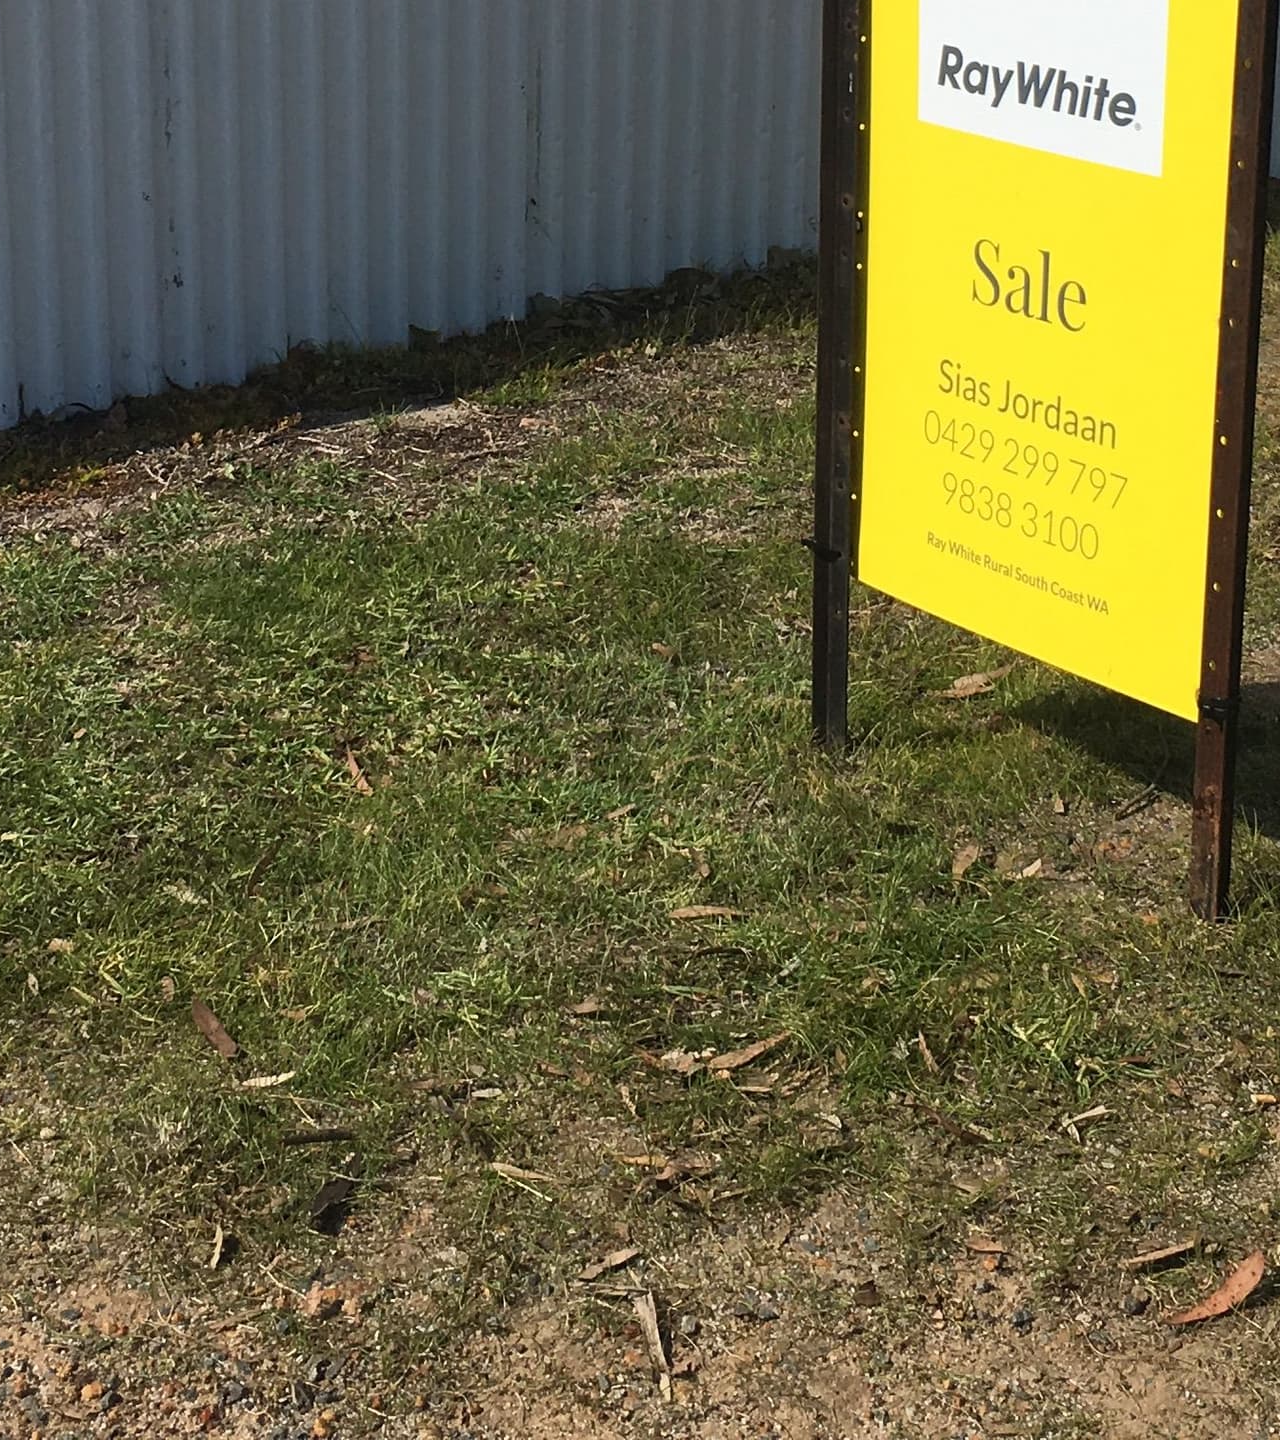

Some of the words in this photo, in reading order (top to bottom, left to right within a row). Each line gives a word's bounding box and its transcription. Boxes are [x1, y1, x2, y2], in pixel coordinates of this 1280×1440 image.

[971, 238, 1087, 333] Sale
[938, 358, 991, 408] Sias
[997, 379, 1117, 450] Jordaan
[924, 409, 995, 464] 0429
[1002, 437, 1059, 487] 299
[1069, 458, 1128, 510] 797
[942, 471, 1012, 528] 9838
[1020, 501, 1099, 560] 3100
[927, 531, 947, 553] Ray
[948, 540, 982, 566] White
[983, 554, 1014, 578] Rural
[1015, 566, 1048, 593] South
[1050, 581, 1085, 607] Coast
[1086, 594, 1110, 616] WA
